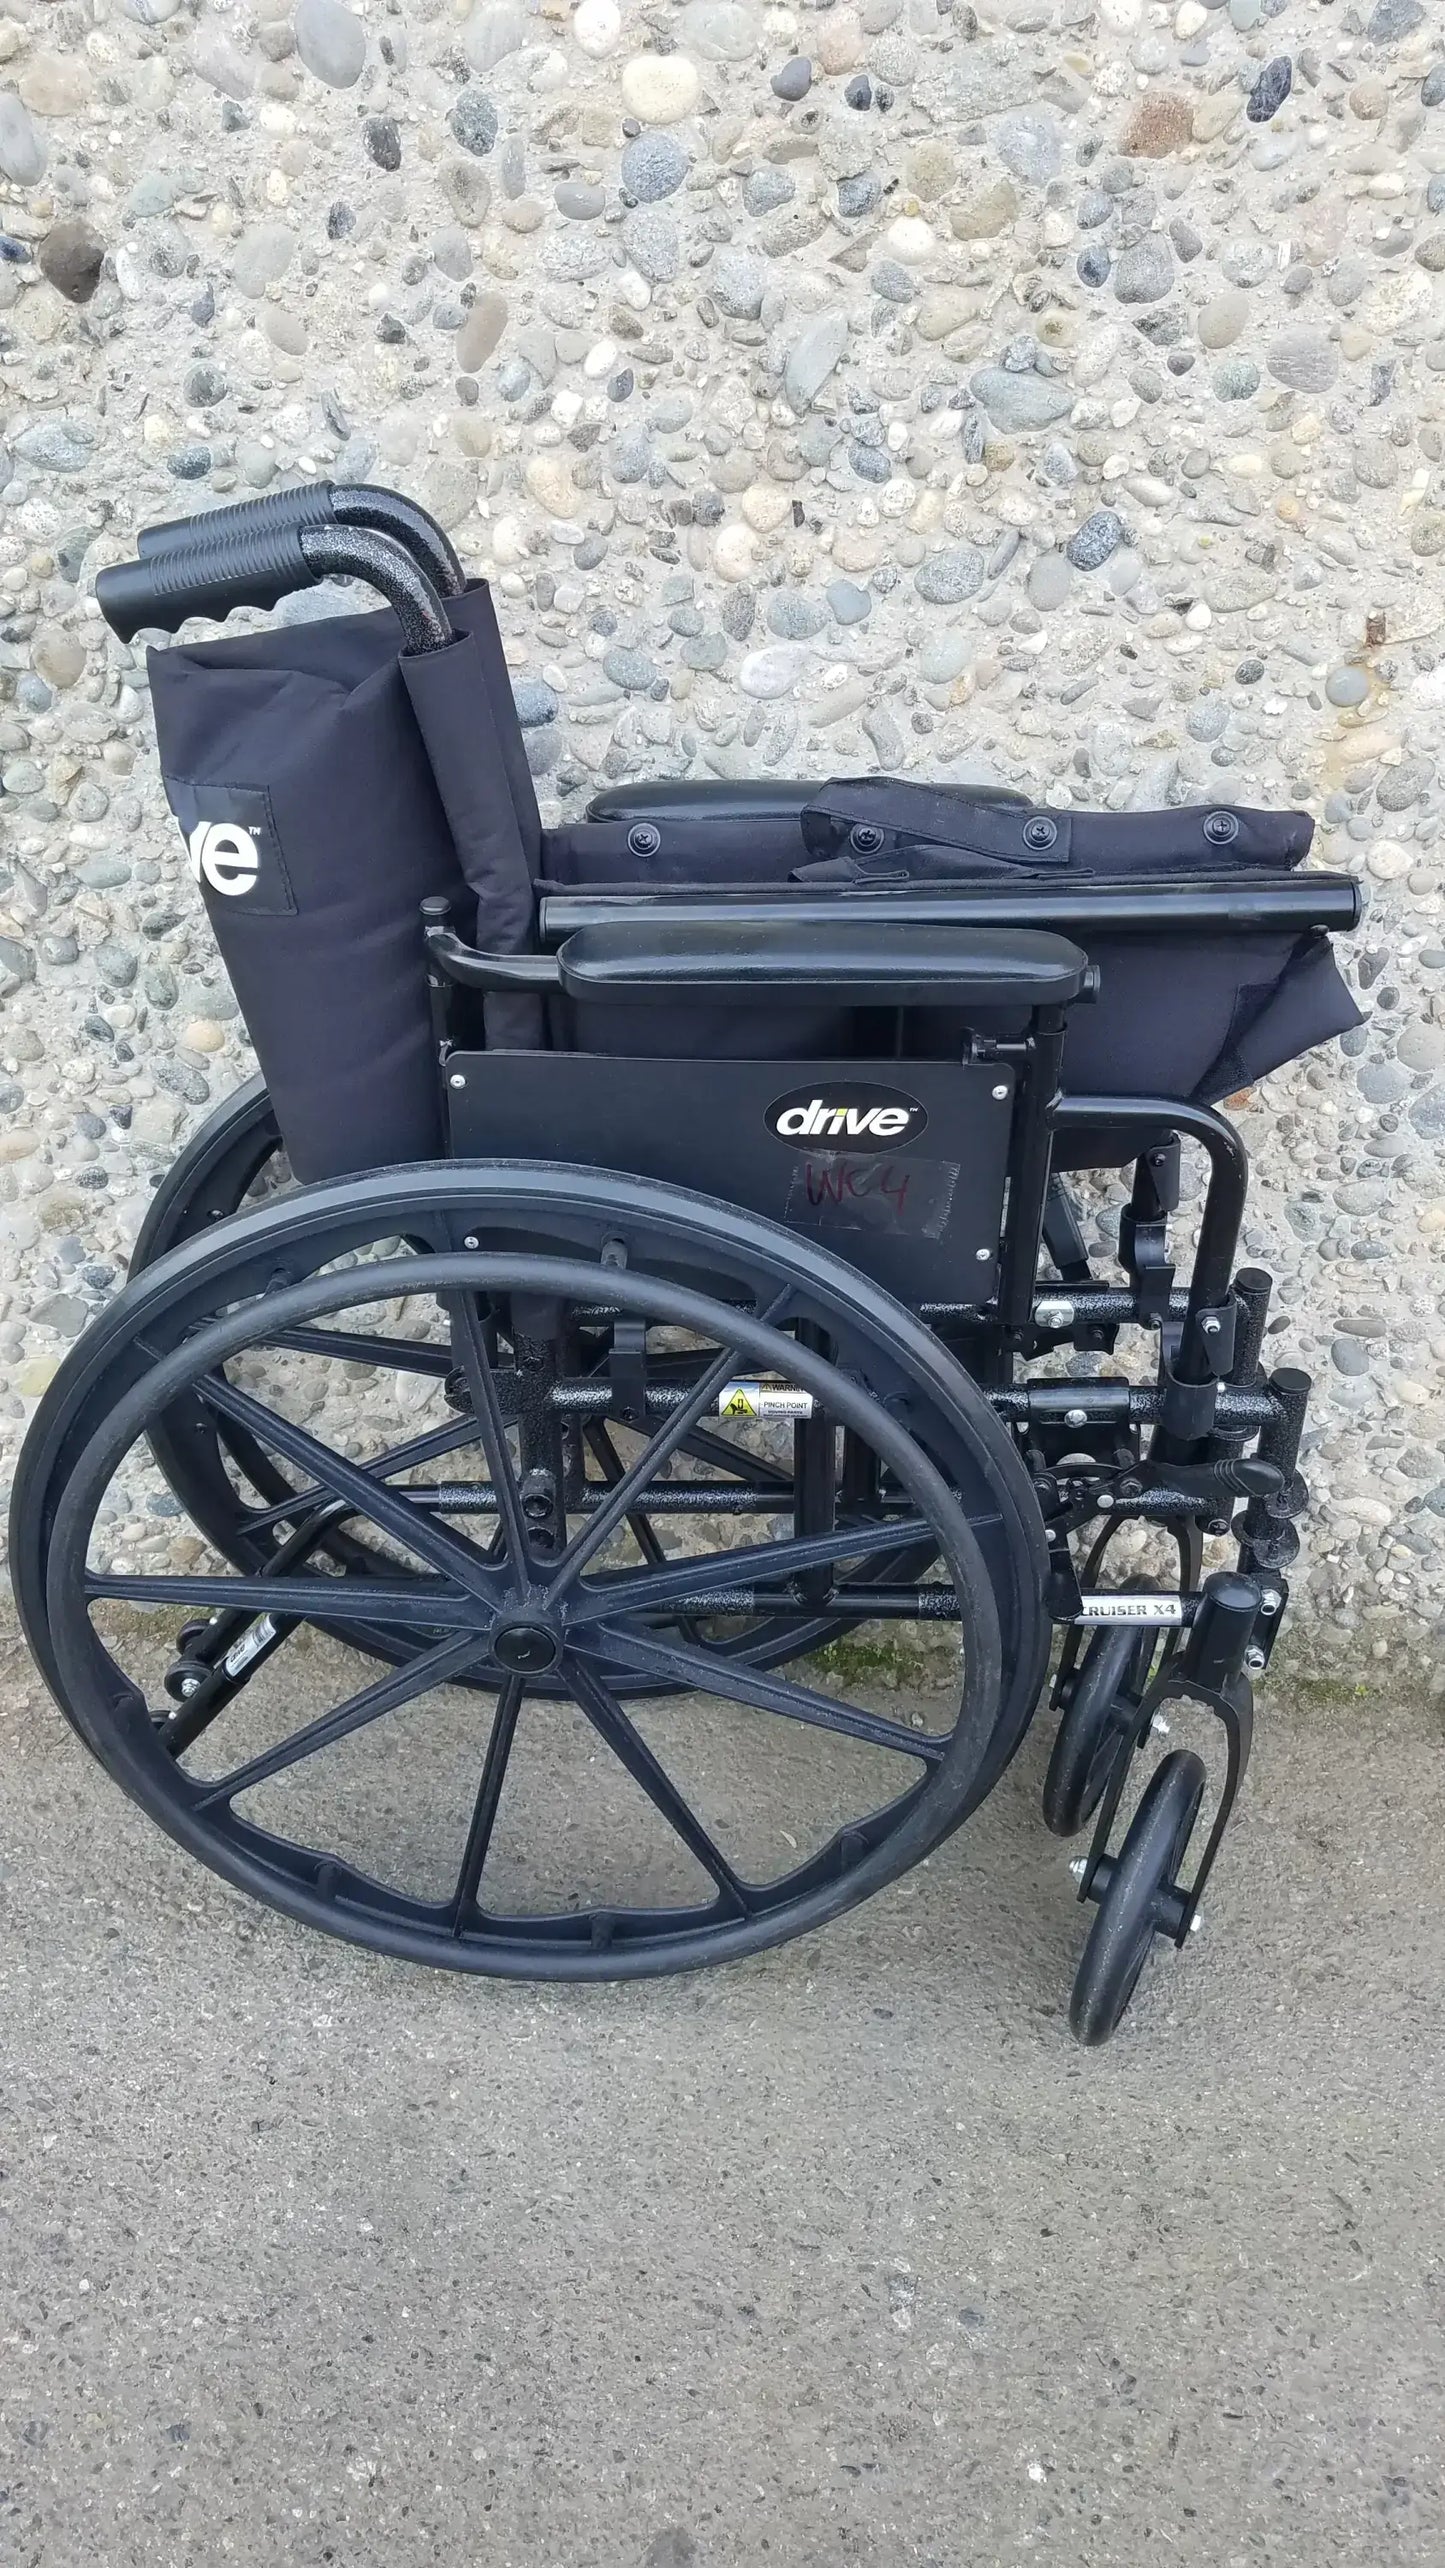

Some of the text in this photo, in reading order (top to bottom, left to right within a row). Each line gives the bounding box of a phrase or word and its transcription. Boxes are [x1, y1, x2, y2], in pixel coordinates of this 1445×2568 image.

[776, 1099, 910, 1136] drive
[763, 1401, 785, 1409] PINCH
[1154, 1604, 1177, 1616] X4
